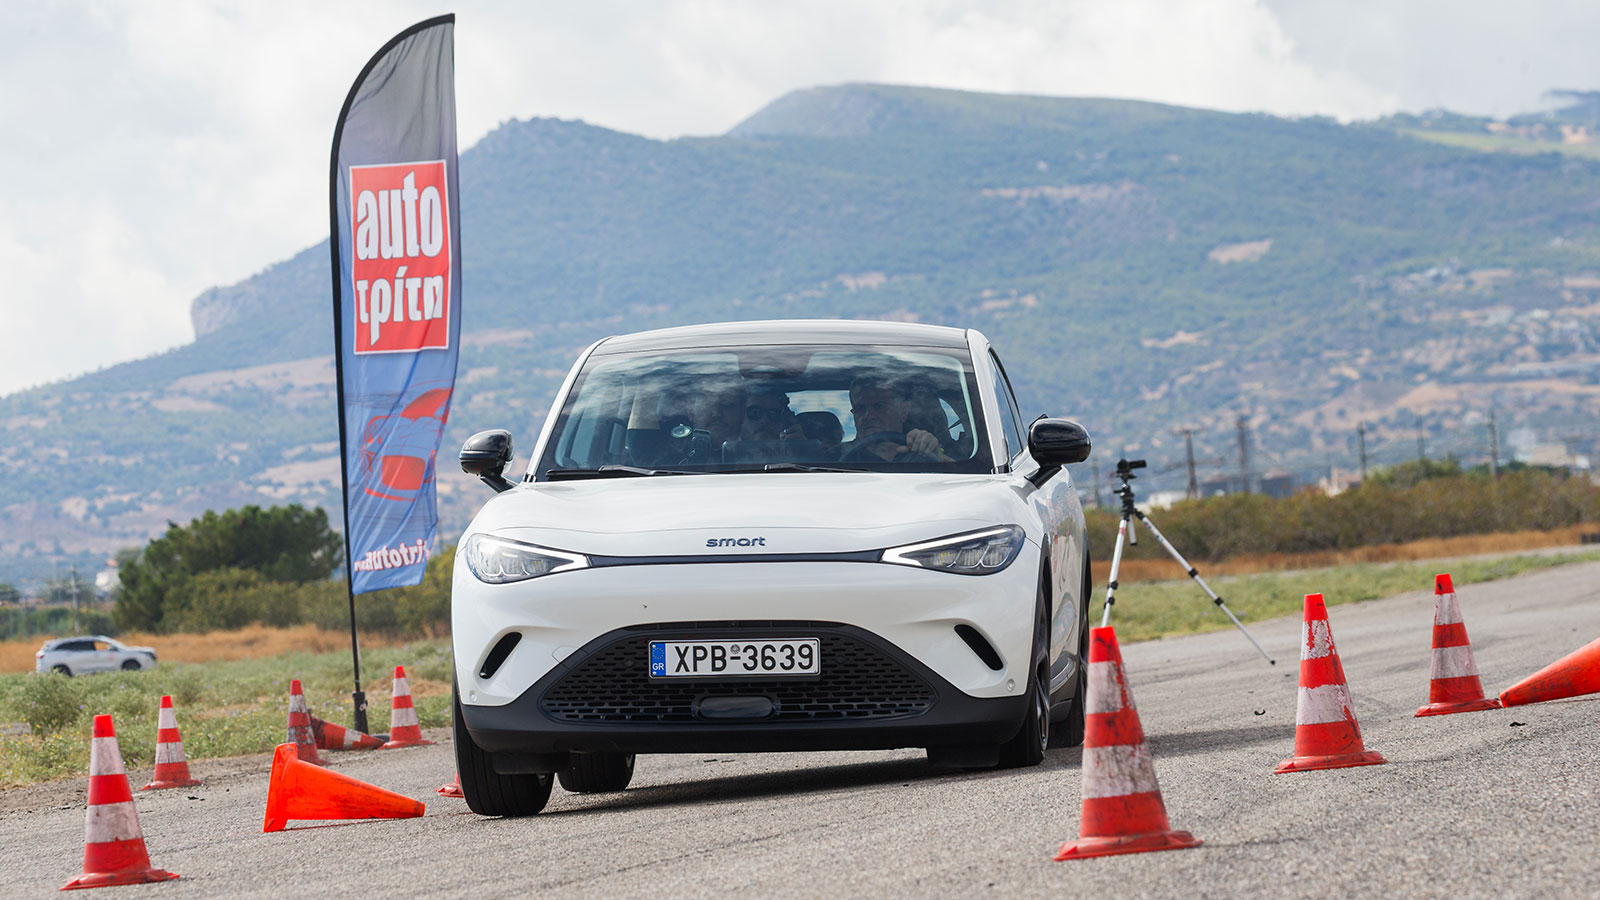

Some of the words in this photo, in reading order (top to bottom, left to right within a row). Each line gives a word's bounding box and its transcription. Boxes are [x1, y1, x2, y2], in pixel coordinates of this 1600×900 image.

[356, 170, 444, 261] auto
[705, 536, 766, 548] smart
[652, 662, 665, 671] GR
